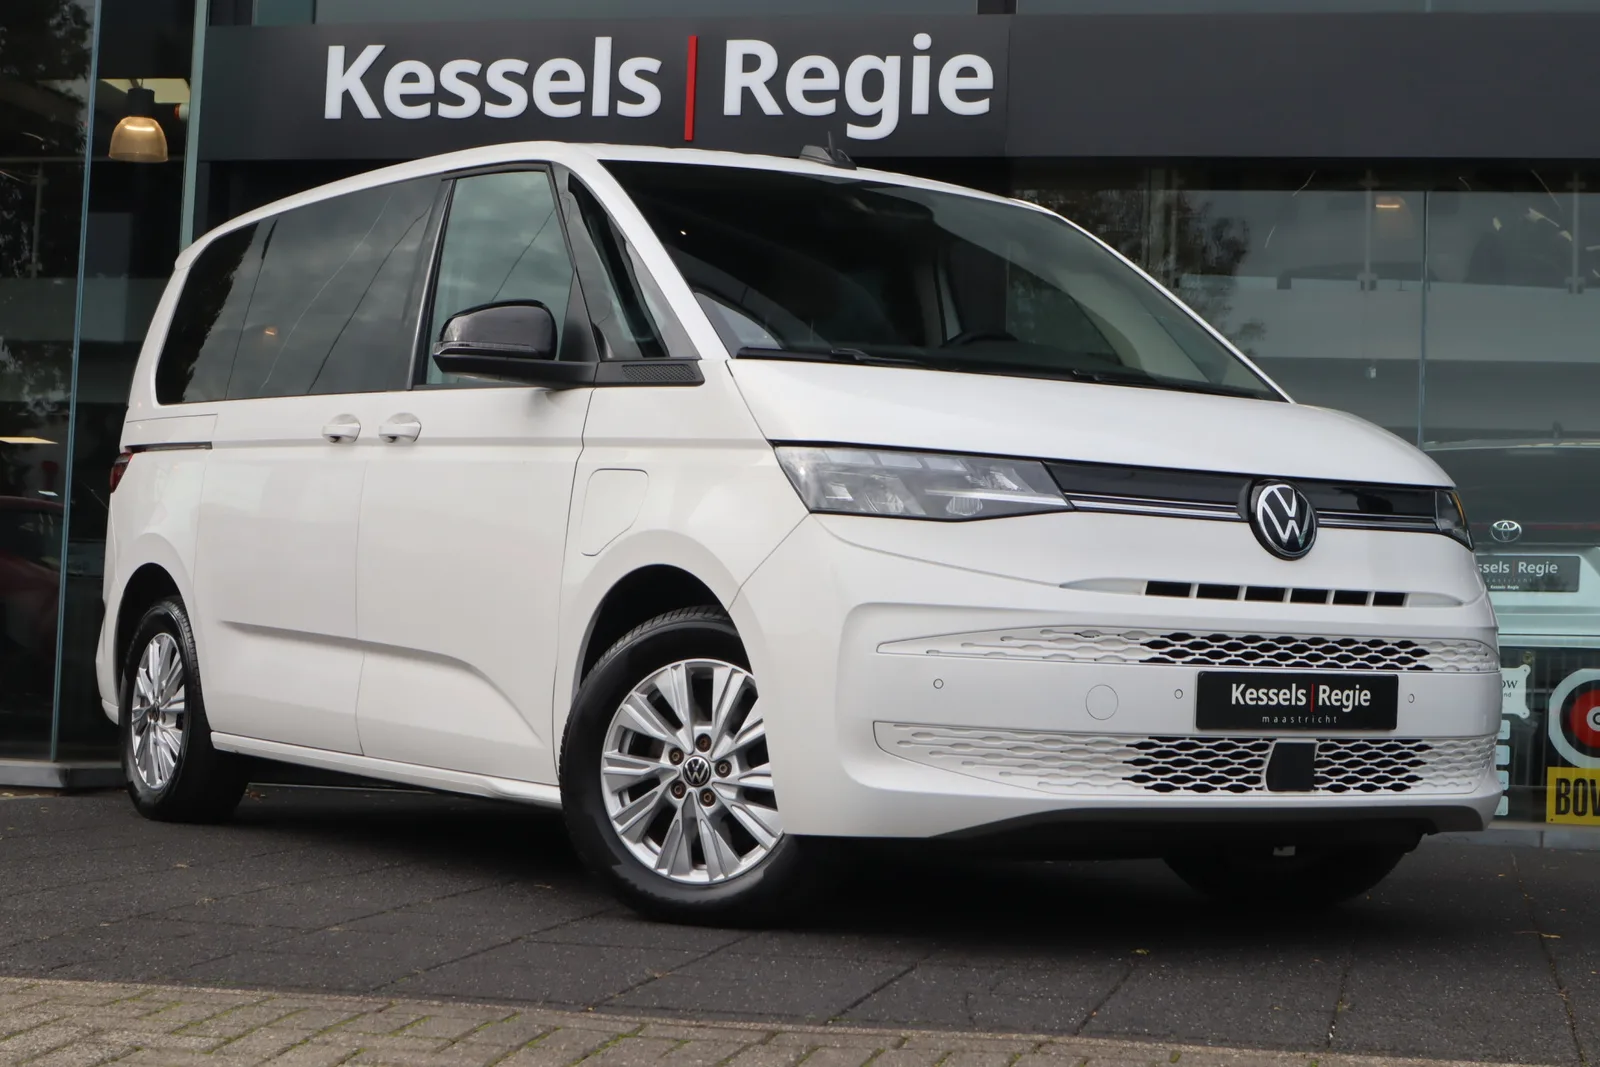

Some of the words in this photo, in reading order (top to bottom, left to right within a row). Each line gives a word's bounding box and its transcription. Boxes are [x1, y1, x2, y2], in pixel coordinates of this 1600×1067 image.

[324, 36, 662, 120] Kessels
[722, 33, 994, 140] Regie
[1477, 561, 1510, 574] ssels
[1518, 561, 1559, 577] Regie
[1231, 683, 1307, 706] Kessels
[1318, 685, 1372, 713] Regie
[1261, 714, 1338, 724] maastricht
